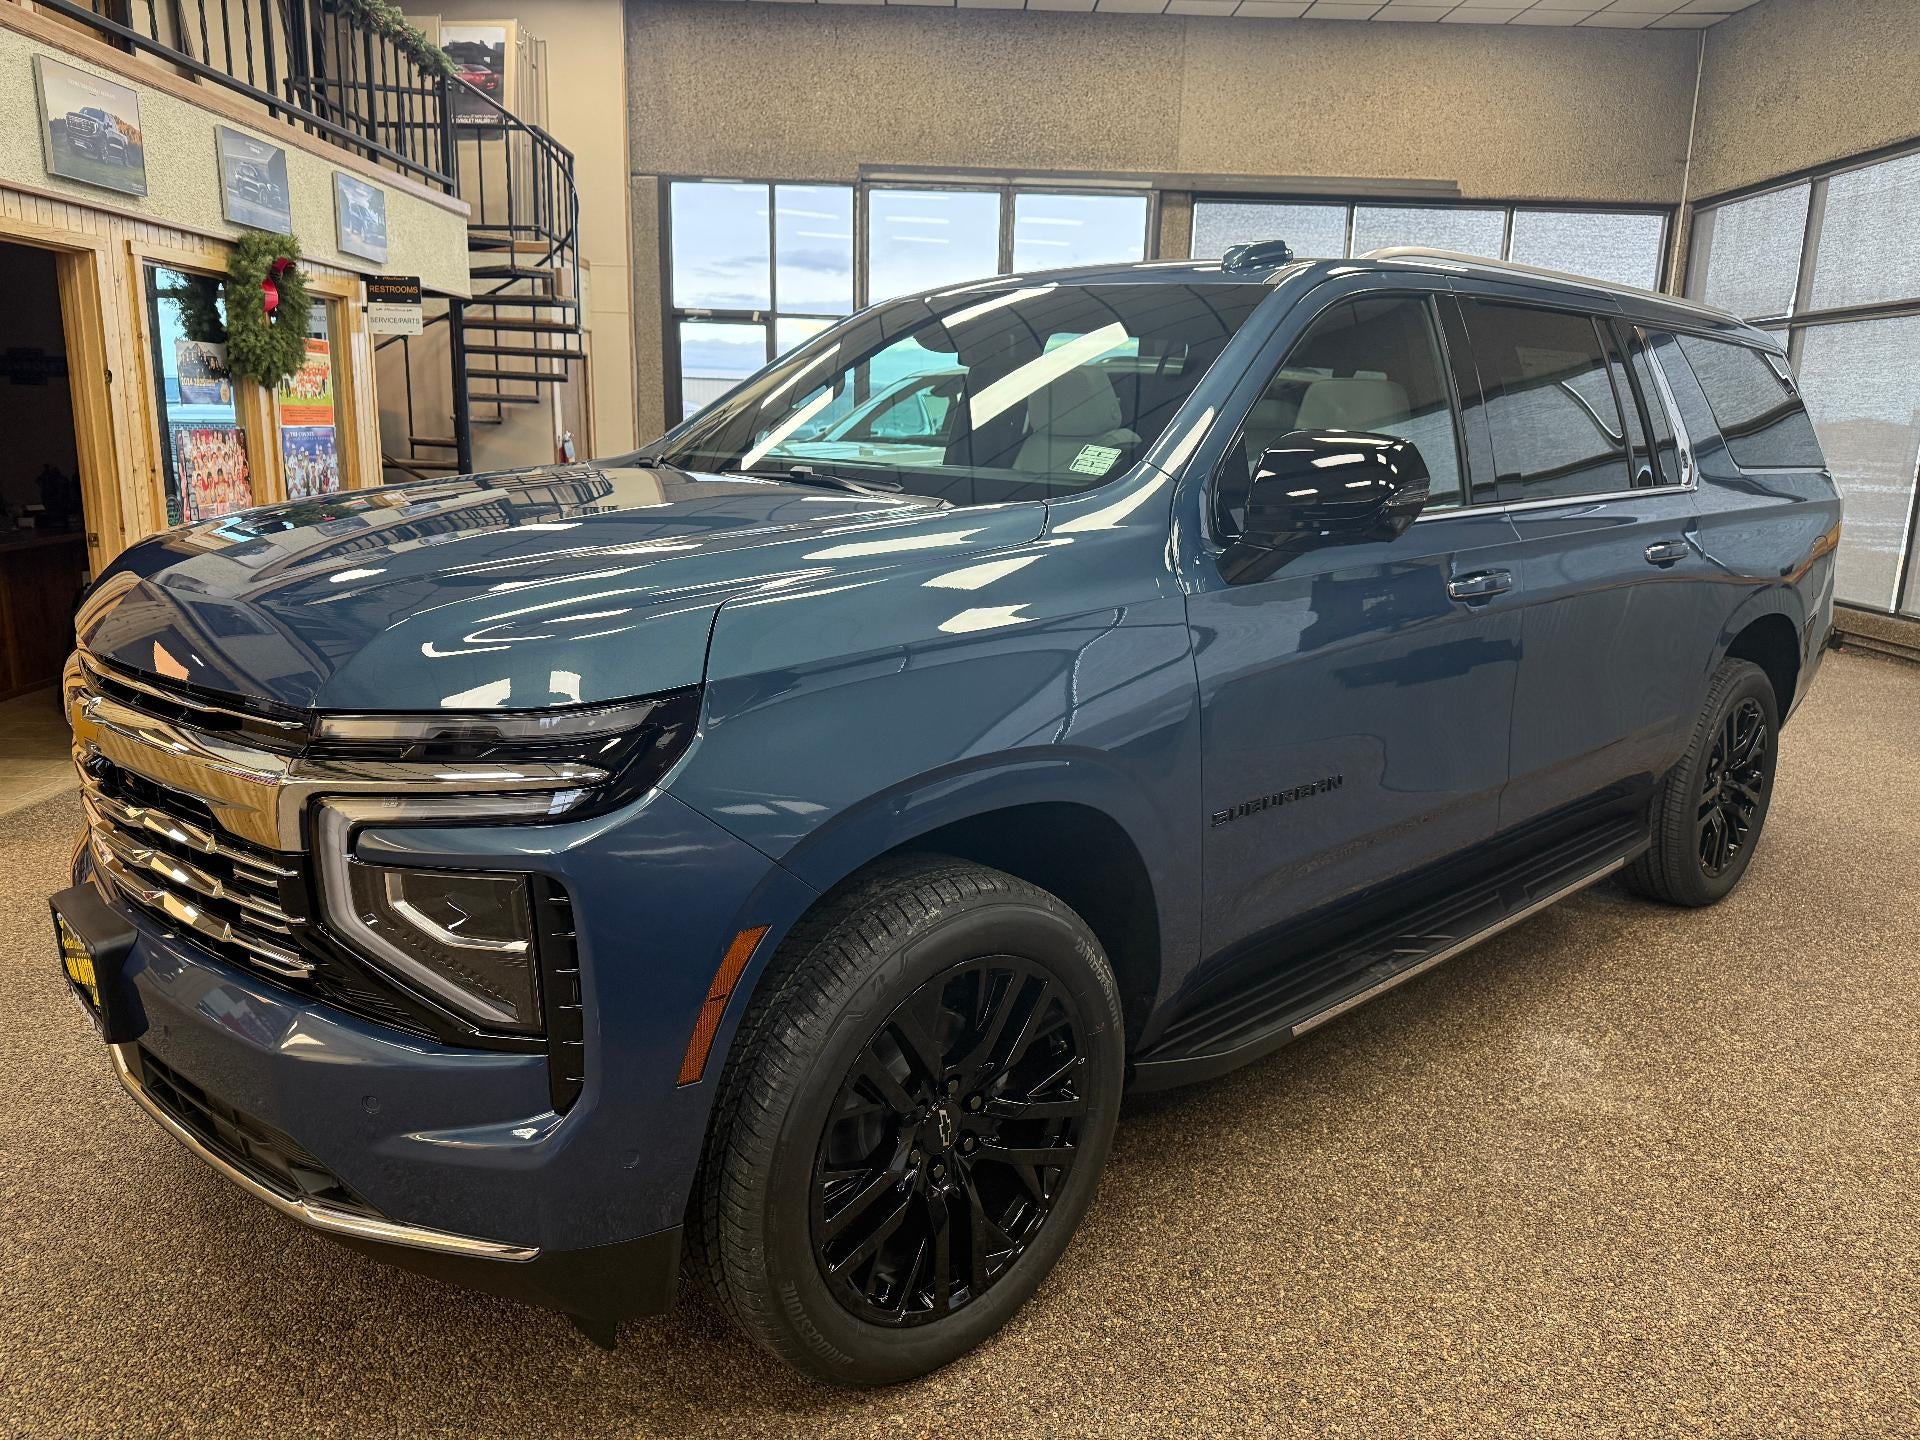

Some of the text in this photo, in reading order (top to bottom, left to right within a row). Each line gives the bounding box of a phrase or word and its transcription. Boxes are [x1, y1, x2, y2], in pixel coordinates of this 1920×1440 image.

[369, 285, 418, 294] RESTROOMS
[370, 316, 420, 325] SERVICE/PARTS
[1211, 774, 1343, 827] SUBURBAN
